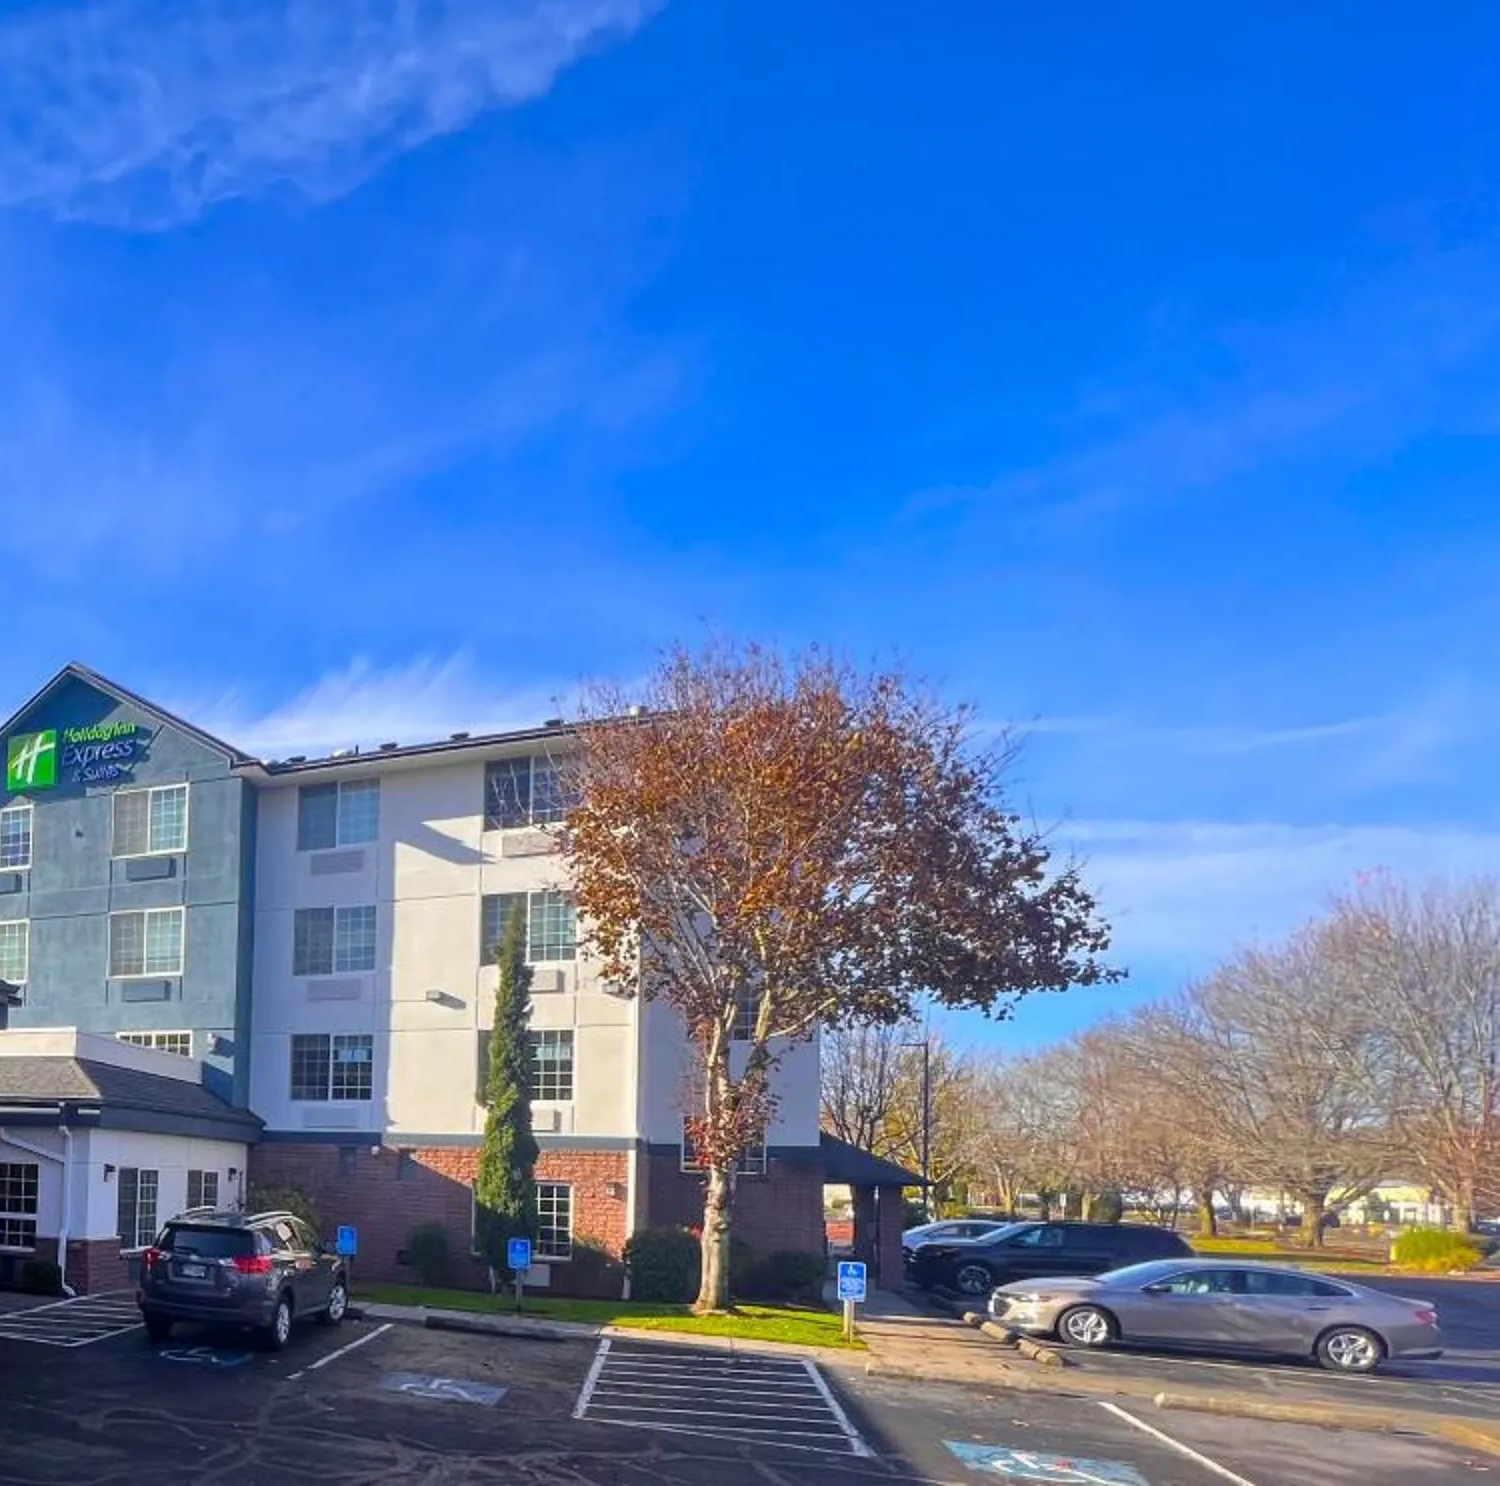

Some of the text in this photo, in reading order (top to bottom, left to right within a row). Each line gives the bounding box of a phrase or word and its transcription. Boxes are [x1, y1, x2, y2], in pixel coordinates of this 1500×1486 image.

[113, 721, 135, 737] Inn
[62, 739, 134, 768] Express
[83, 763, 120, 781] Suites
